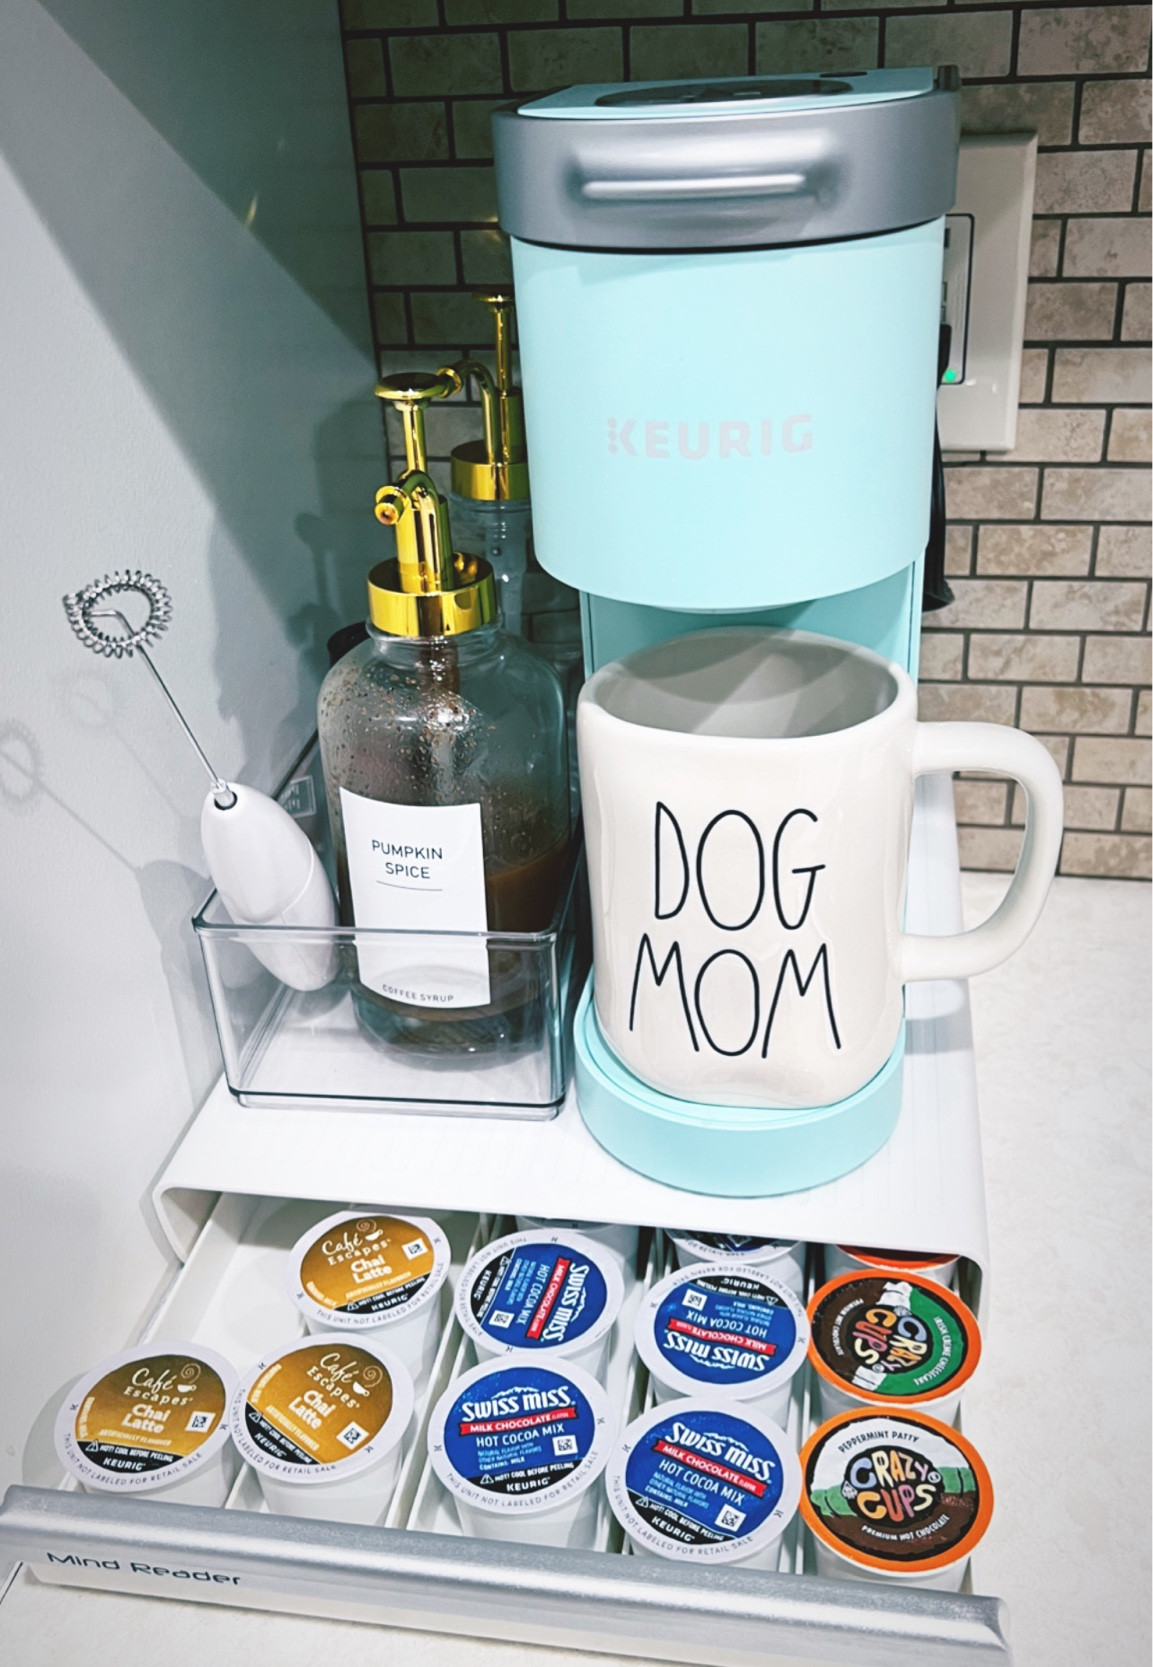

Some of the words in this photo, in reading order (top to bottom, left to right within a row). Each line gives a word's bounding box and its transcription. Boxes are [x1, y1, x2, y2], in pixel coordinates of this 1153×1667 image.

[607, 413, 813, 460] KEURIG
[372, 839, 443, 860] PUMPKIN
[385, 862, 430, 879] SPICE
[655, 802, 826, 931] DOG
[382, 984, 417, 999] COFFEE
[420, 993, 454, 1002] SYRUP
[629, 933, 841, 1059] MOM
[322, 1232, 363, 1255] Café
[328, 1239, 388, 1266] Escapes
[351, 1255, 385, 1272] Chai
[353, 1266, 392, 1284] Latte
[536, 1264, 550, 1281] HOT
[554, 1265, 564, 1283] MILK
[474, 1270, 492, 1300] KEURIG
[525, 1283, 543, 1311] COCOA
[562, 1263, 589, 1306] SWISS
[723, 1278, 759, 1290] KEURIG
[317, 1310, 330, 1320] THIS
[334, 1316, 350, 1324] UNIT
[372, 1308, 406, 1323] LABELED
[408, 1298, 421, 1310] FOR
[371, 1294, 409, 1311] KEURIG
[538, 1284, 559, 1320] CHOCOLATE
[516, 1309, 530, 1325] MIX
[686, 1310, 707, 1324] MIX
[710, 1316, 743, 1331] COCOA
[693, 1328, 743, 1343] CHOCOLATE
[746, 1324, 767, 1338] HOT
[853, 1308, 897, 1364] CUPS
[881, 1317, 927, 1371] CRAZY
[745, 1339, 766, 1350] MILK
[320, 1352, 359, 1383] Café
[712, 1346, 770, 1372] SWISS
[132, 1368, 177, 1392] Café
[307, 1366, 356, 1408] Escapes
[123, 1386, 187, 1406] Escapes
[304, 1390, 336, 1417] Chai
[462, 1397, 519, 1422] SWISS
[523, 1386, 568, 1411] MISS
[122, 1414, 164, 1433] Latte
[132, 1404, 170, 1421] Chai
[288, 1397, 322, 1429] Latte
[470, 1422, 493, 1432] MILK
[495, 1415, 551, 1431] CHOCOLATE
[255, 1433, 286, 1457] KEURIG
[476, 1436, 498, 1447] HOT
[502, 1431, 539, 1445] COCOA
[543, 1424, 564, 1436] MIX
[838, 1431, 889, 1453] PEPPERMINT
[892, 1431, 920, 1443] PATTY
[103, 1457, 143, 1470] KEURIG
[238, 1440, 264, 1463] LABELED
[265, 1460, 280, 1471] FOR
[283, 1465, 311, 1474] RETAIL
[511, 1457, 524, 1465] MILK
[663, 1445, 684, 1460] MILK
[686, 1455, 740, 1483] CHOCOLATE
[665, 1422, 726, 1456] SWISS
[724, 1446, 775, 1481] MISS
[79, 1464, 90, 1475] NOT
[91, 1472, 126, 1485] LABELED
[151, 1467, 180, 1481] RETAIL
[182, 1453, 202, 1470] SALE
[447, 1473, 459, 1488] THIS
[461, 1487, 479, 1499] UNIT
[482, 1497, 498, 1506] NOT
[502, 1497, 542, 1507] LABELED
[544, 1488, 560, 1500] FOR
[562, 1470, 585, 1490] RETAIL
[585, 1451, 598, 1470] SALE
[511, 1471, 526, 1479] COOL
[527, 1466, 548, 1476] BEFORE
[550, 1462, 574, 1471] PEELING
[850, 1450, 929, 1489] CRAZY
[506, 1478, 550, 1492] KEURIG
[659, 1460, 684, 1477] HOT
[683, 1468, 718, 1494] COCOA
[721, 1487, 744, 1506] MIX
[857, 1484, 936, 1522] CUPS
[615, 1494, 627, 1512] UNIT
[625, 1514, 638, 1530] NOT
[638, 1527, 673, 1550] LABELED
[677, 1546, 694, 1554] FOR
[700, 1546, 729, 1555] RETAIL
[732, 1537, 753, 1548] SALE
[652, 1516, 695, 1542] KEURIG
[664, 1508, 678, 1521] COOL
[679, 1516, 700, 1531] BEFORE
[700, 1525, 724, 1541] PEELING
[861, 1525, 897, 1541] PREMIUM
[900, 1532, 914, 1541] HOT
[916, 1514, 950, 1538] CHOCOLATE
[47, 1552, 120, 1570] Mind
[130, 1562, 241, 1585] Reader
